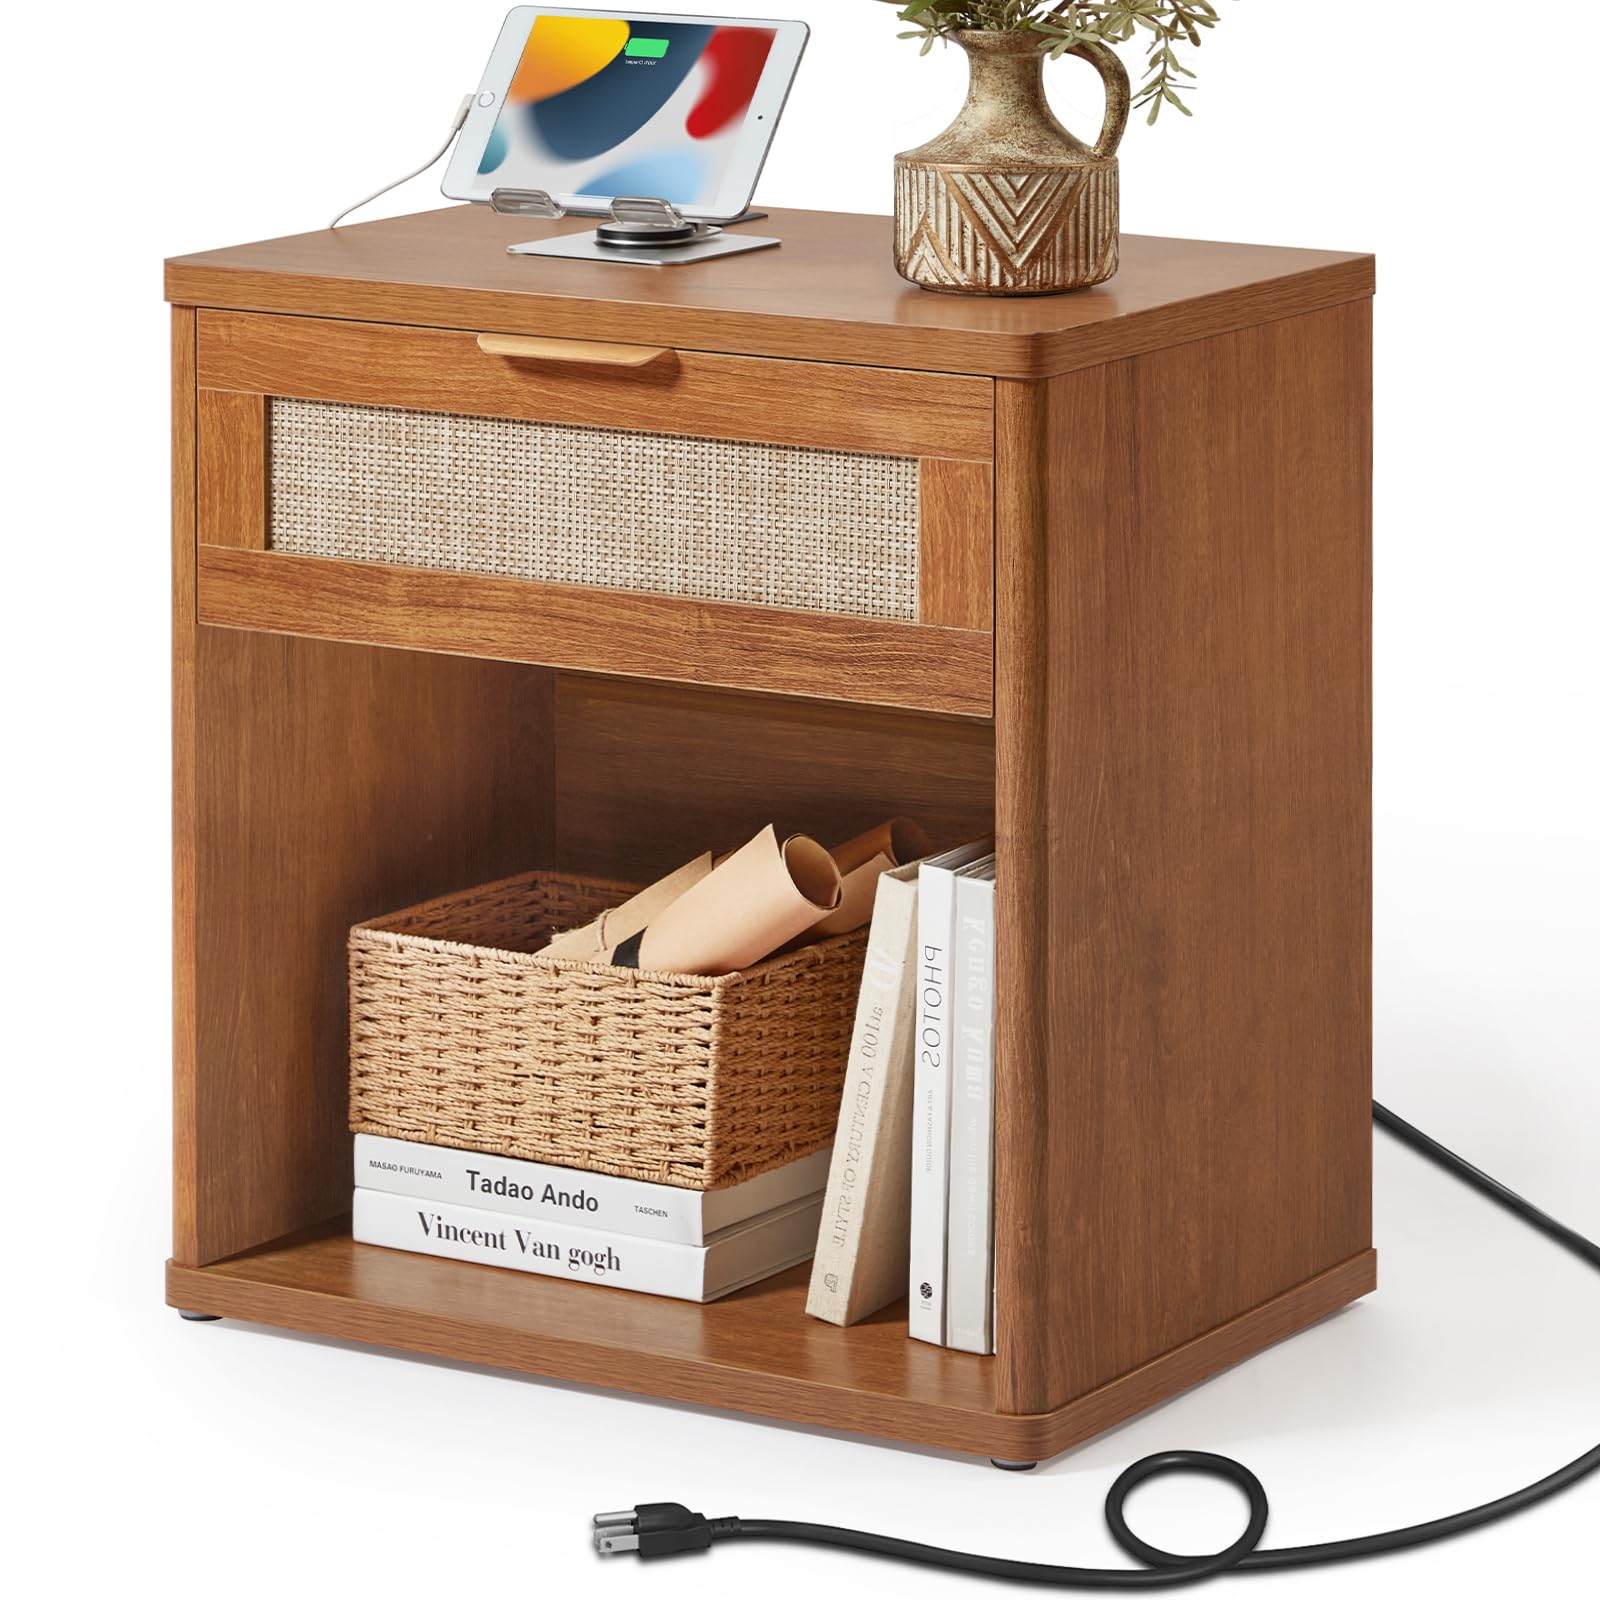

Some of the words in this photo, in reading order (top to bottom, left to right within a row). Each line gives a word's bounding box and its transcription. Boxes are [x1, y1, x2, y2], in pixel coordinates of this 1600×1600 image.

[368, 1159, 398, 1173] MASAO
[399, 1163, 443, 1180] FURUYAMA
[465, 1168, 535, 1201] Tadao
[539, 1183, 600, 1213] Ando
[633, 1204, 669, 1219] TASCHEN
[416, 1210, 507, 1251] Vincent
[513, 1228, 561, 1261] Van
[567, 1245, 621, 1277] gogh
